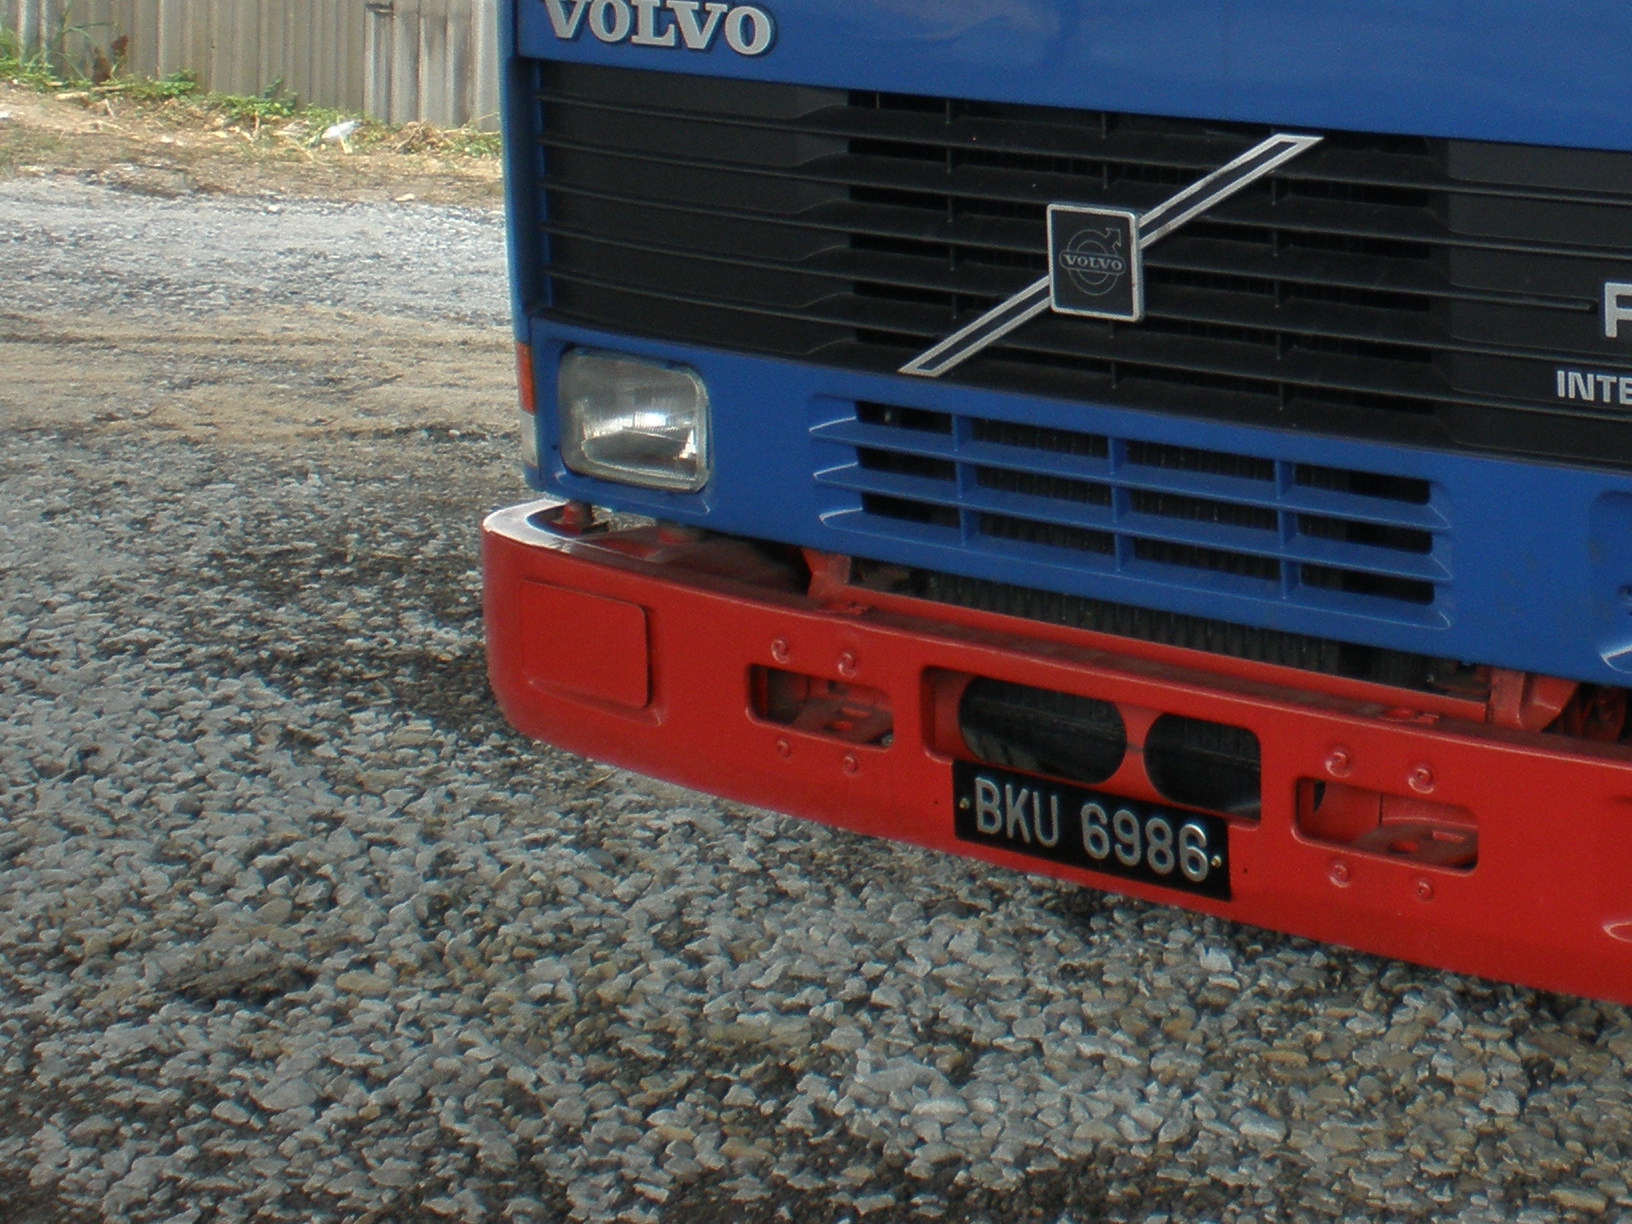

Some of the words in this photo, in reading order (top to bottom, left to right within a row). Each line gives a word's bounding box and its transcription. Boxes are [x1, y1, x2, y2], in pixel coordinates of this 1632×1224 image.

[1063, 253, 1123, 271] VOLVO
[975, 777, 1060, 847] BKU
[1080, 802, 1209, 882] 6986
